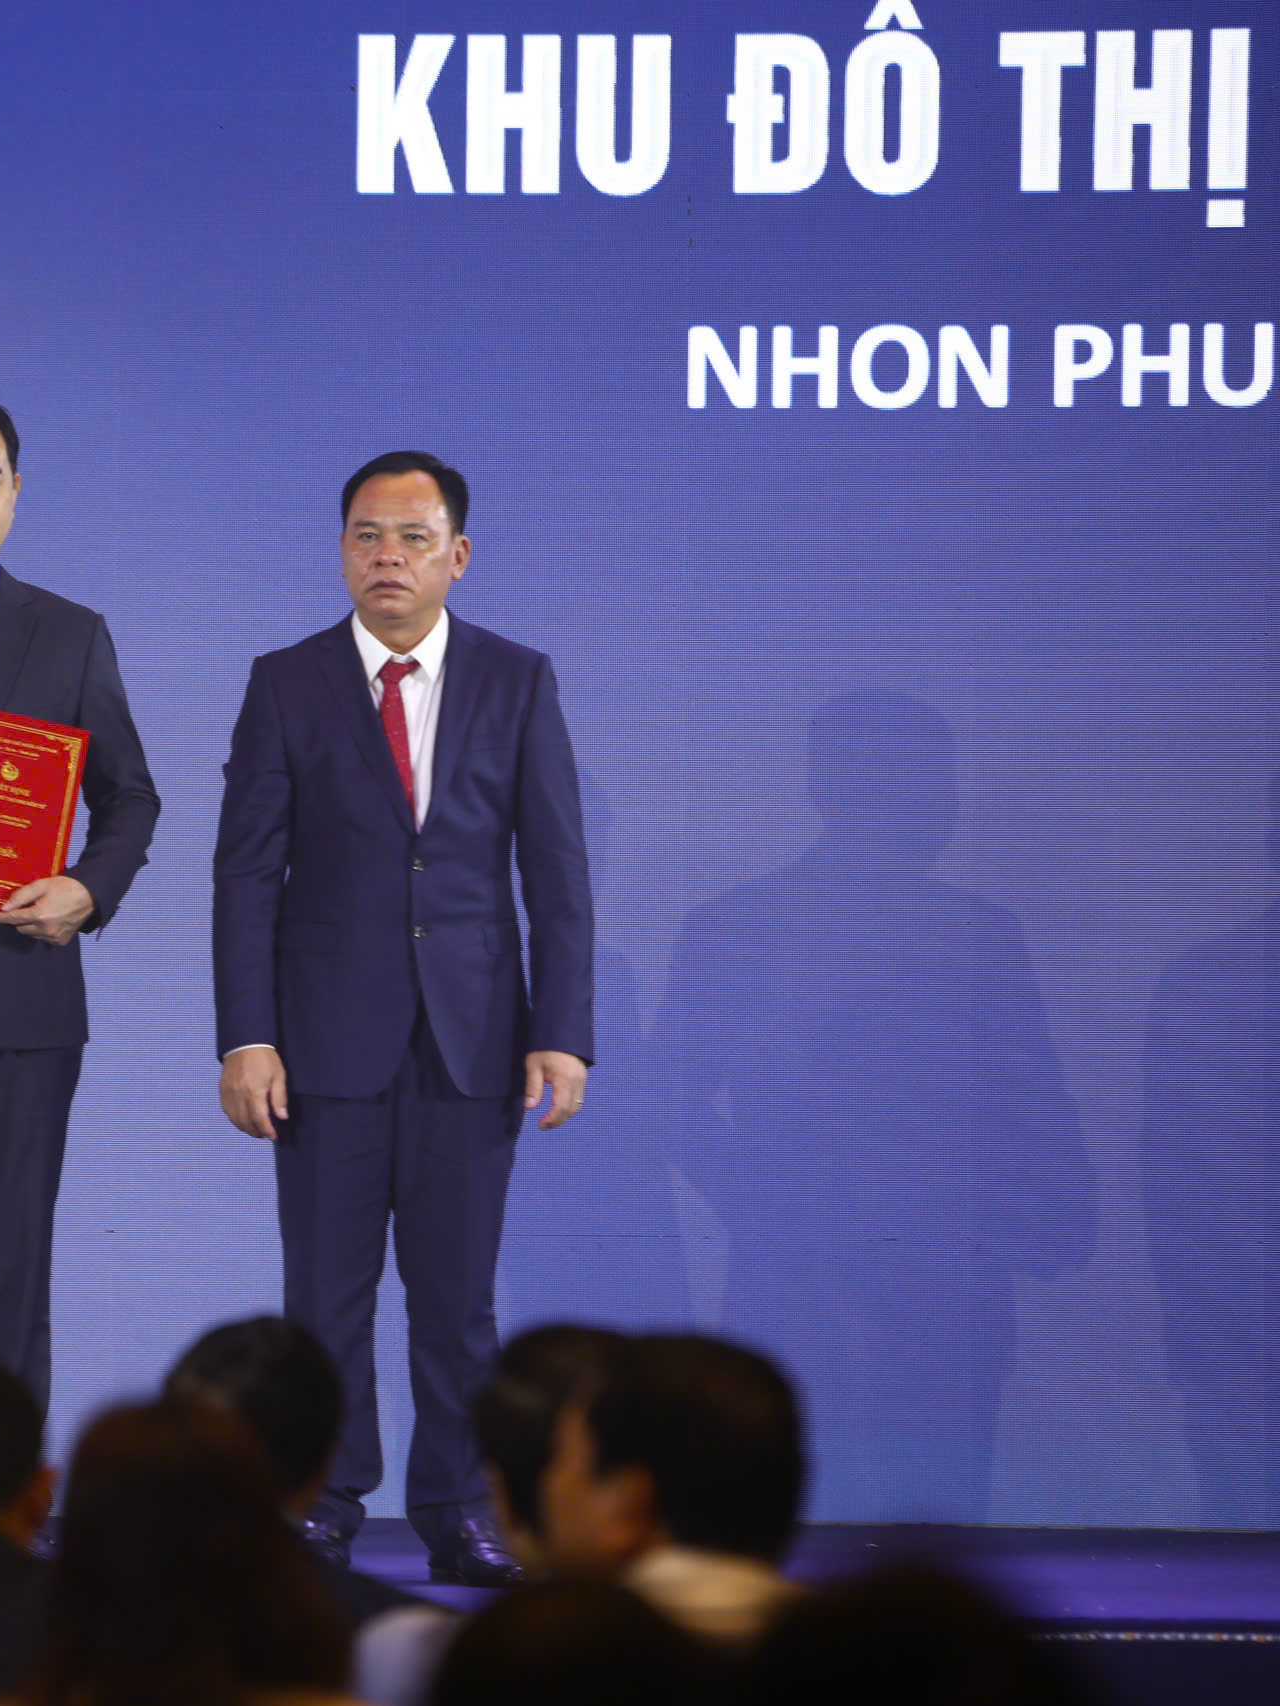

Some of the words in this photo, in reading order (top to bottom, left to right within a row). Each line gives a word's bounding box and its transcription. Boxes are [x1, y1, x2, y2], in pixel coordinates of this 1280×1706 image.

[356, 34, 672, 196] KHU
[726, 0, 941, 195] ĐÔ
[999, 28, 1251, 229] THỊ
[687, 324, 1009, 410] NHON
[1053, 322, 1276, 408] PHU
